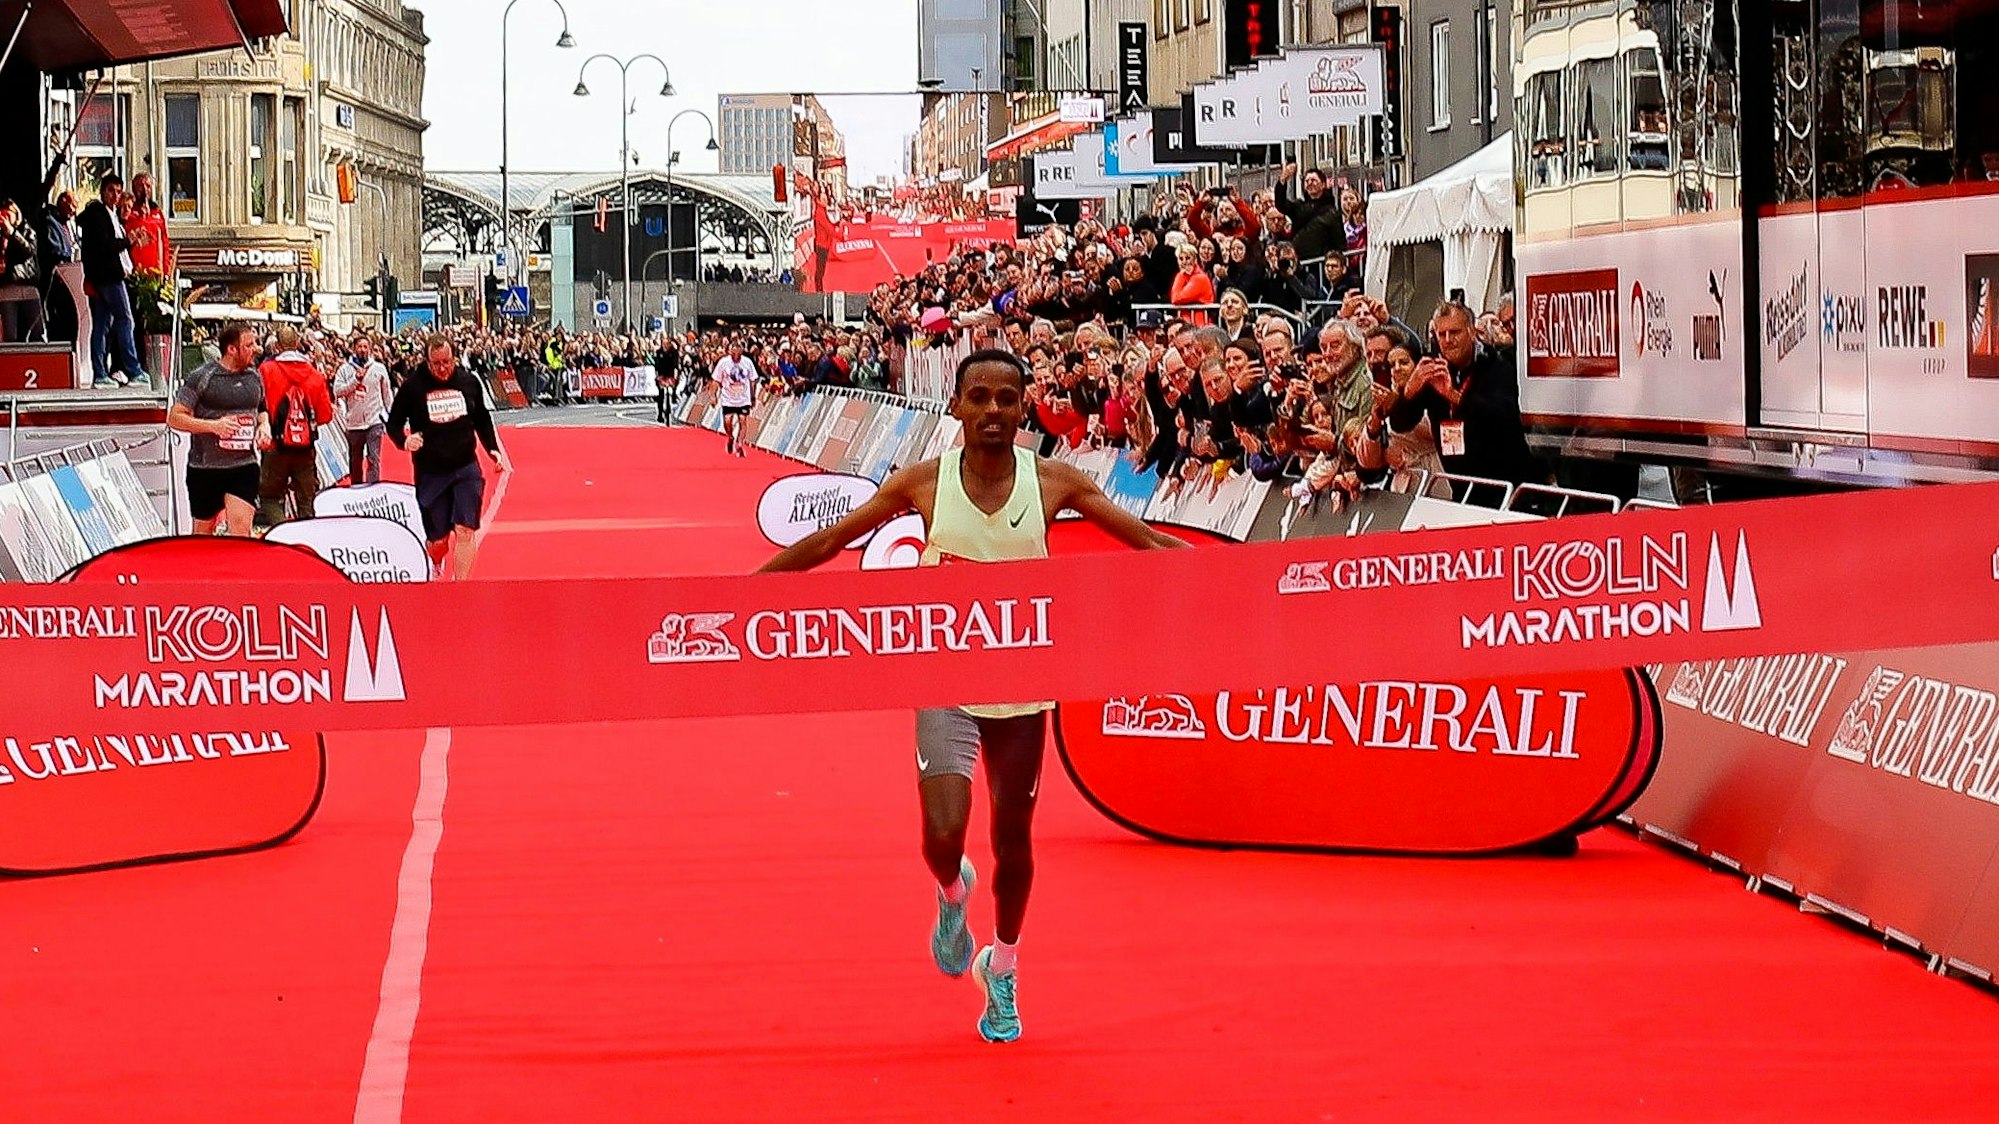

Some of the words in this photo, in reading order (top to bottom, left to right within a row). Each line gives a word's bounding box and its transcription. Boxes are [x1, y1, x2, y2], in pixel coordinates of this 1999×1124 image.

[1309, 94, 1368, 109] GENERALI
[1549, 289, 1616, 358] GENERALI
[1647, 290, 1666, 319] Rhein
[1878, 285, 1928, 348] REWE
[1692, 315, 1721, 360] PUMA
[24, 370, 38, 388] 2
[787, 494, 854, 523] ALKOHOL
[331, 546, 389, 566] Rhein
[346, 566, 412, 583] nergie
[1330, 548, 1505, 591] GENERALI
[1512, 531, 1689, 602] KÖLN
[0, 605, 137, 638] ENERALI
[144, 604, 329, 662] KÖLN
[744, 596, 1055, 661] GENERALI
[1460, 598, 1691, 649] MARATHON
[93, 669, 333, 708] MARATHON
[1214, 682, 1587, 760] GENERALI
[1870, 675, 1999, 806] GENERA
